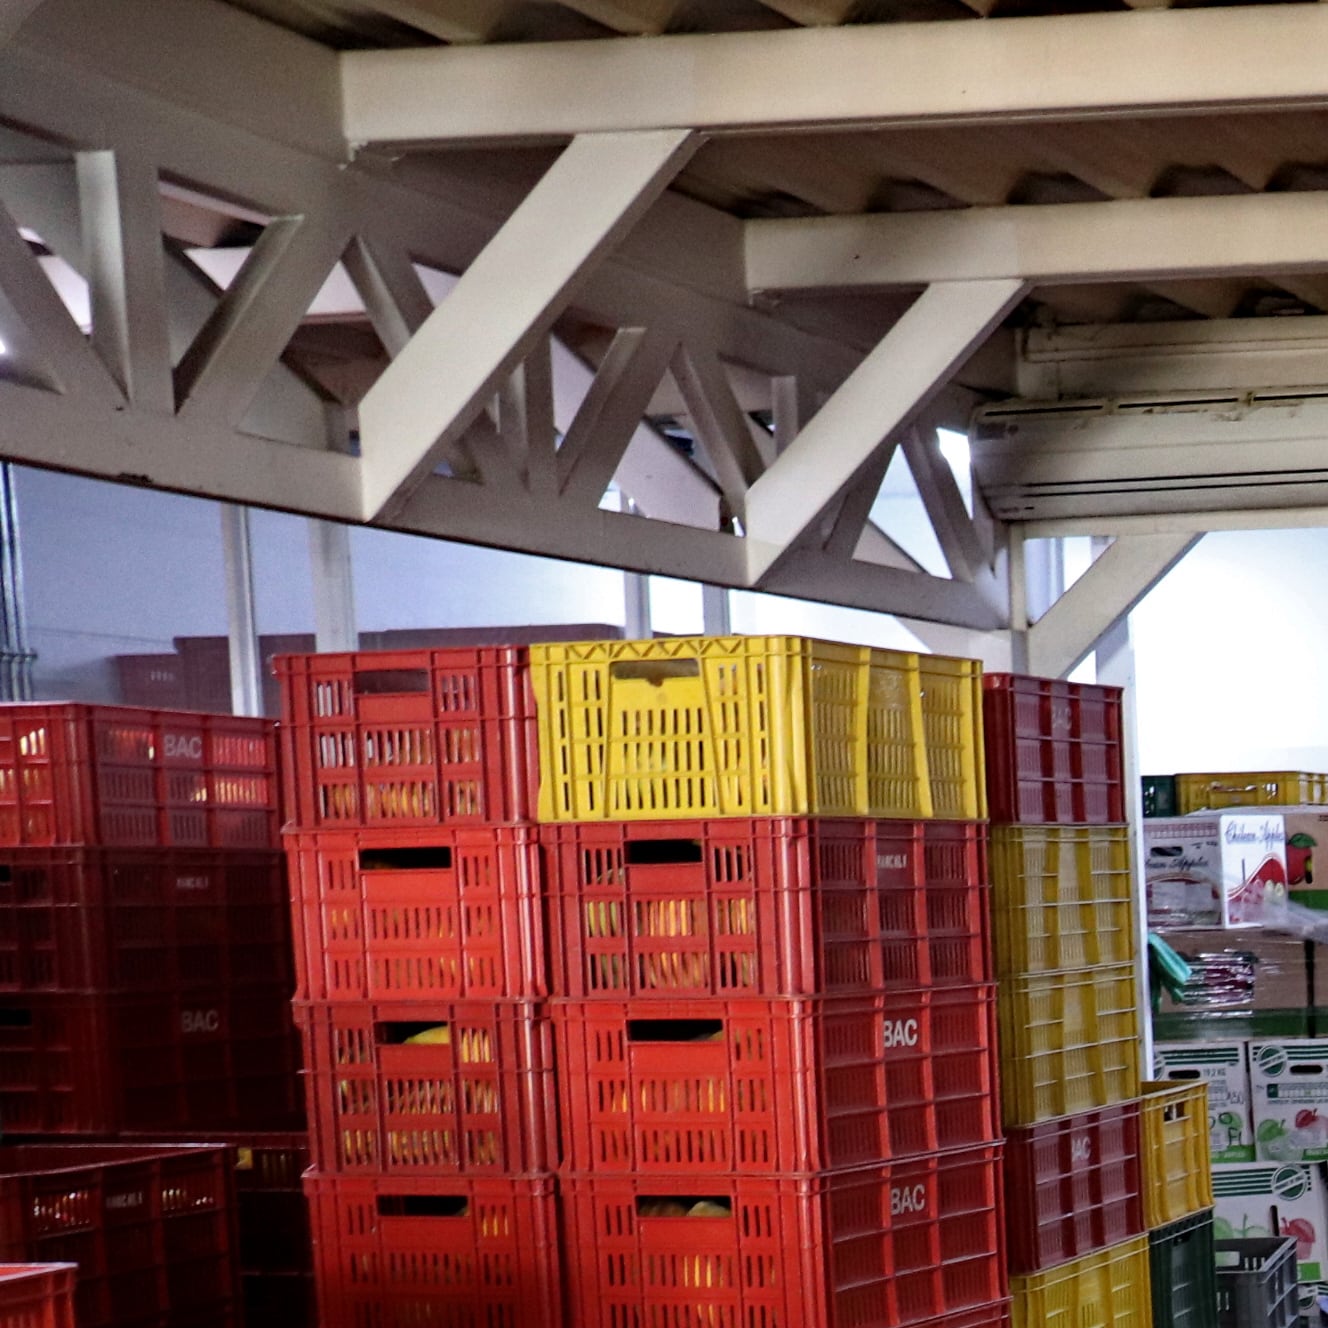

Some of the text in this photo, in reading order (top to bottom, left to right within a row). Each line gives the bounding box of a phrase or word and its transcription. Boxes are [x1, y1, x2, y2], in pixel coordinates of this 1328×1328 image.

[164, 734, 203, 759] BAC
[182, 1010, 218, 1033] BAC
[883, 1019, 918, 1048] BAC
[890, 1184, 925, 1215] BAC
